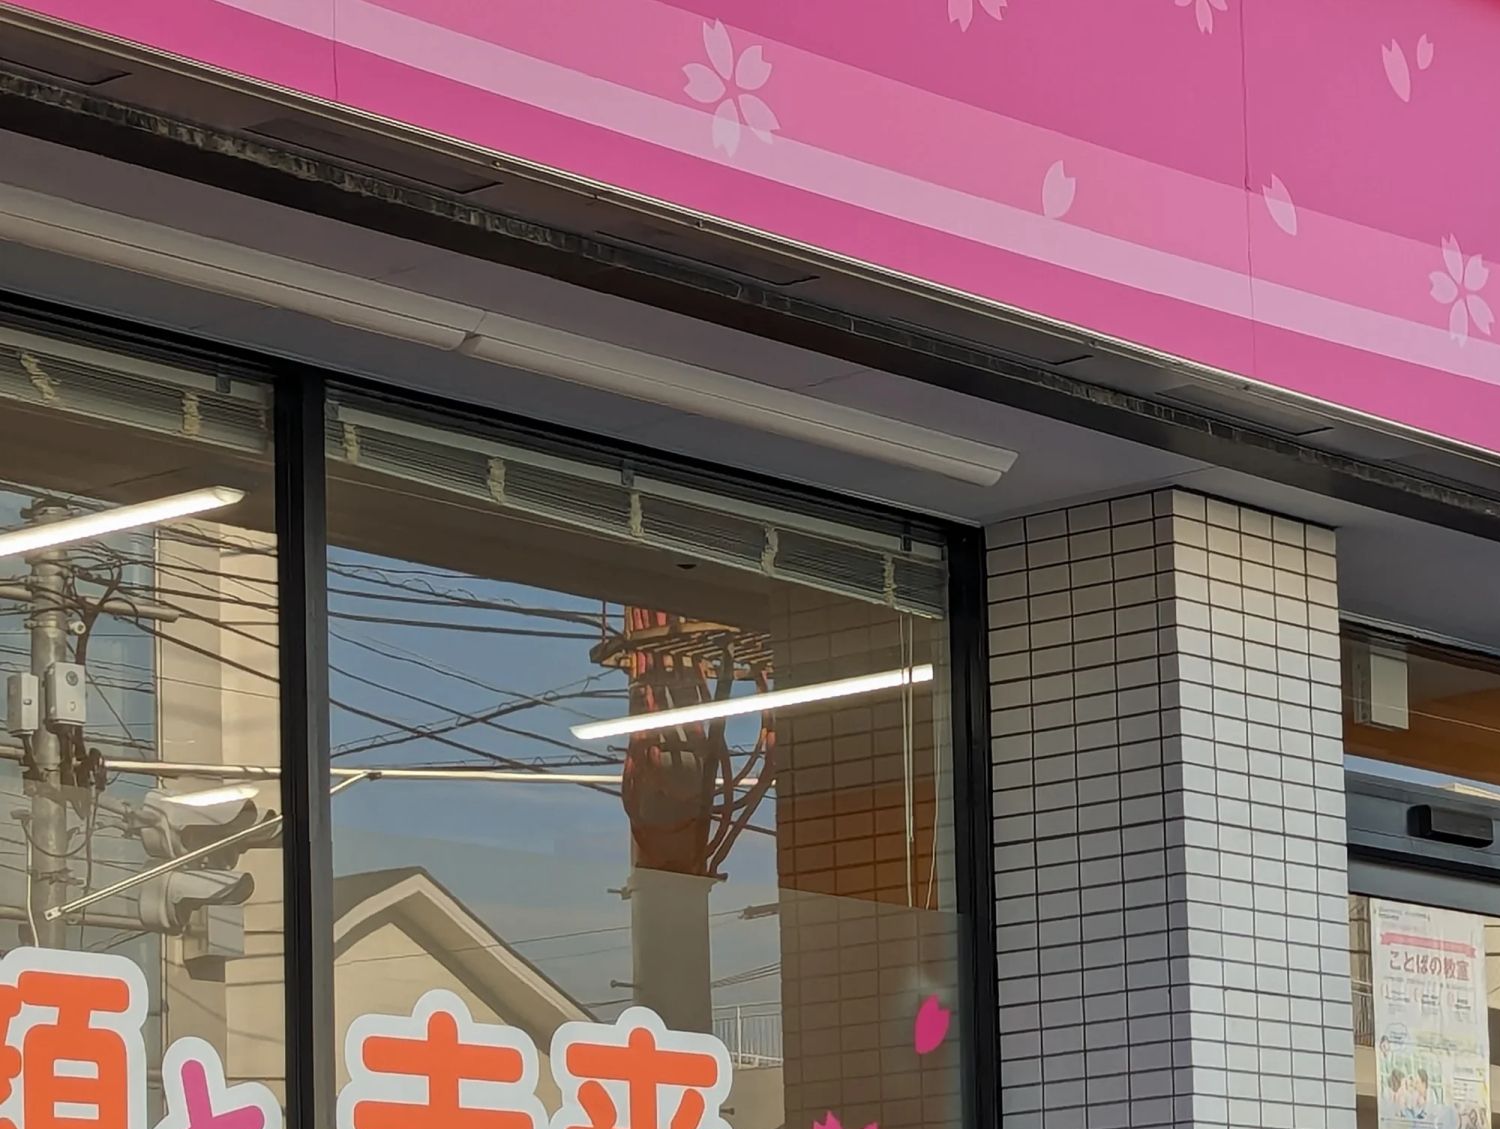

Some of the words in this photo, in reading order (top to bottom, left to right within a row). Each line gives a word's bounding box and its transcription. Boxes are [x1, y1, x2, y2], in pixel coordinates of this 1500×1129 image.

[1390, 951, 1470, 981] ことばの教室
